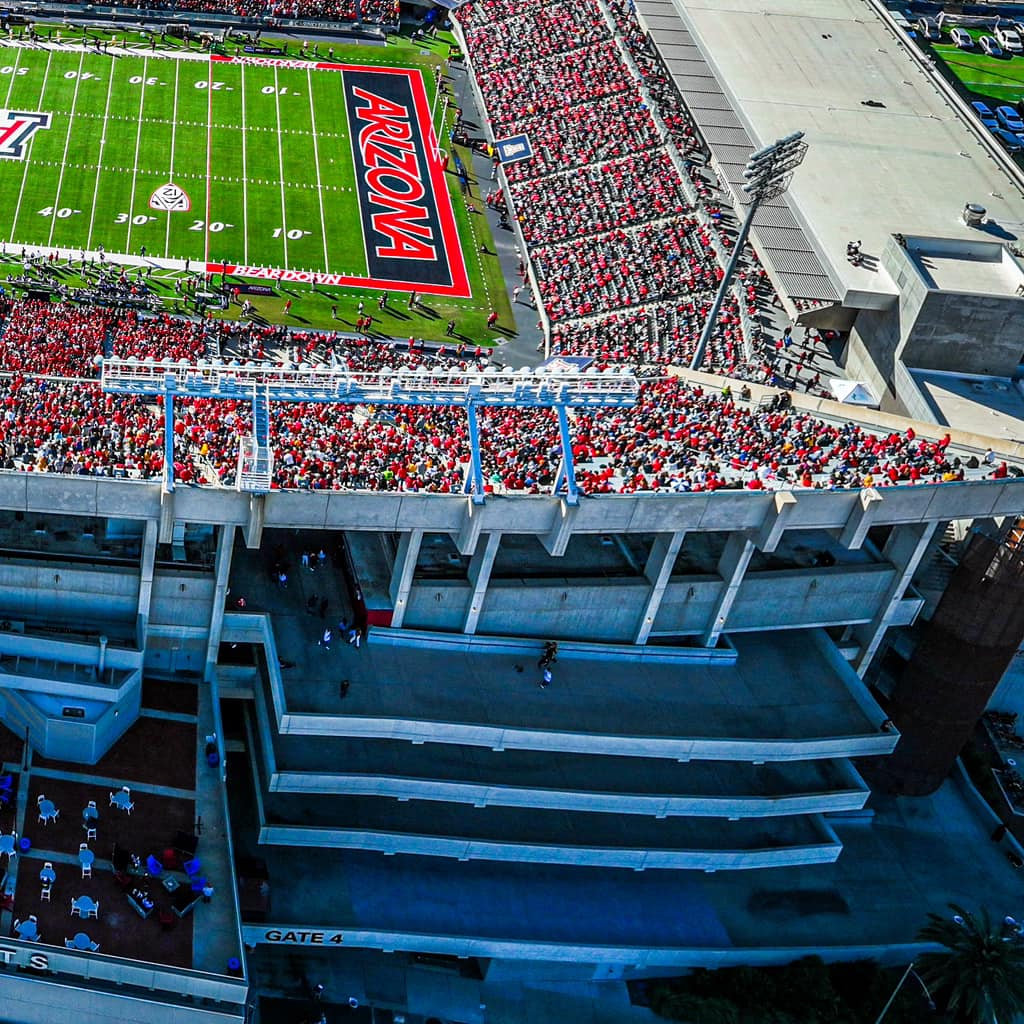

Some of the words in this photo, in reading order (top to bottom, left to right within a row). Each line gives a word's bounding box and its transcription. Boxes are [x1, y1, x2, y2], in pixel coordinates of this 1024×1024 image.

[0, 66, 31, 75] 50
[64, 70, 94, 80] 40
[129, 76, 159, 86] 30
[194, 81, 224, 90] 20
[261, 86, 289, 95] 10
[351, 85, 438, 261] ARIZONA
[37, 206, 73, 218] 40
[114, 213, 149, 225] 30
[188, 220, 226, 232] 20
[272, 228, 304, 240] 10
[264, 930, 324, 944] GATE
[329, 933, 343, 945] 4
